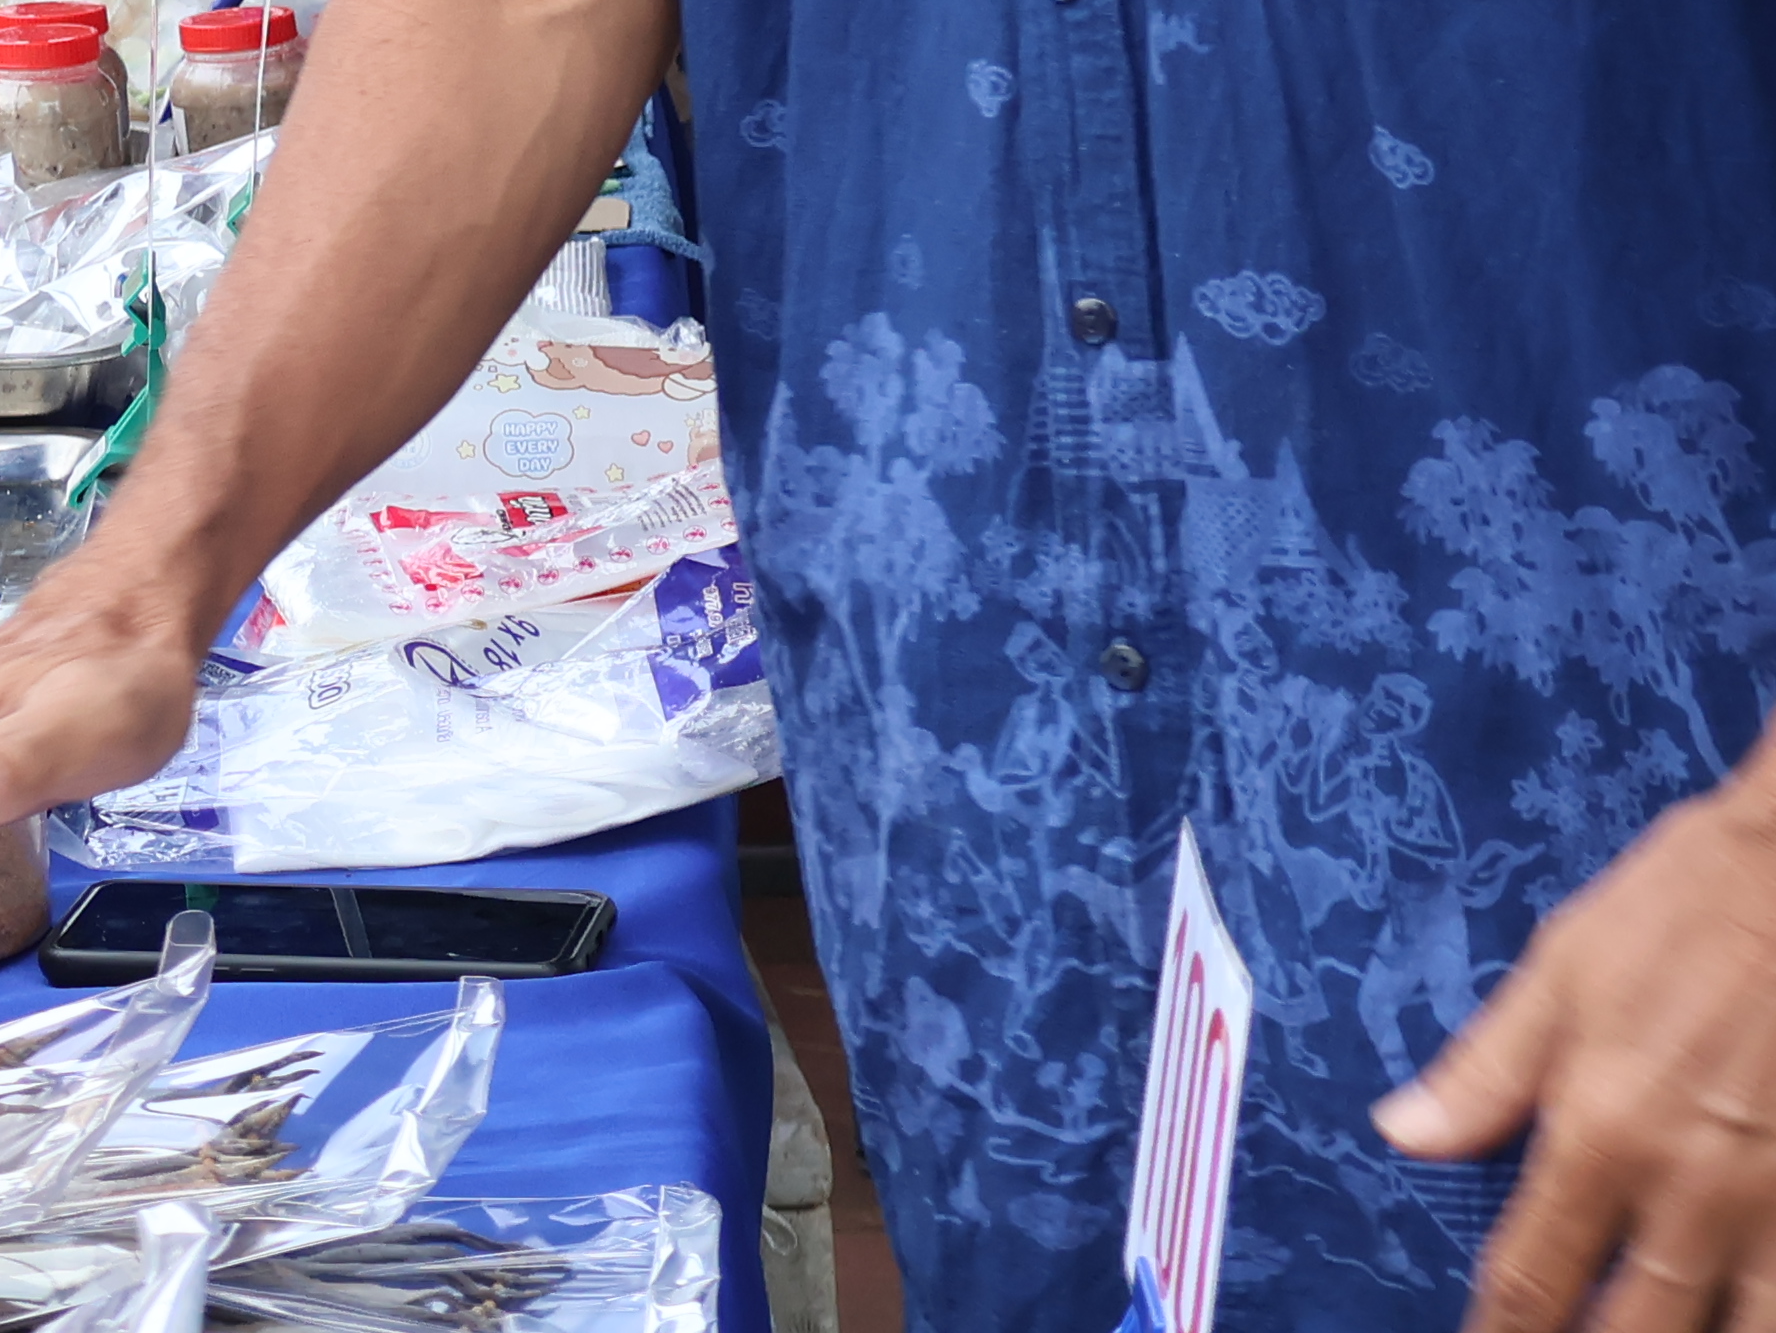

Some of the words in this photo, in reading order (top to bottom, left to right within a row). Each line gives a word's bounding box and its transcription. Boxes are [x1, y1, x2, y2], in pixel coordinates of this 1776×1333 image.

[504, 422, 558, 437] HAPPY
[505, 440, 559, 455] EVERY
[518, 457, 552, 473] DAY
